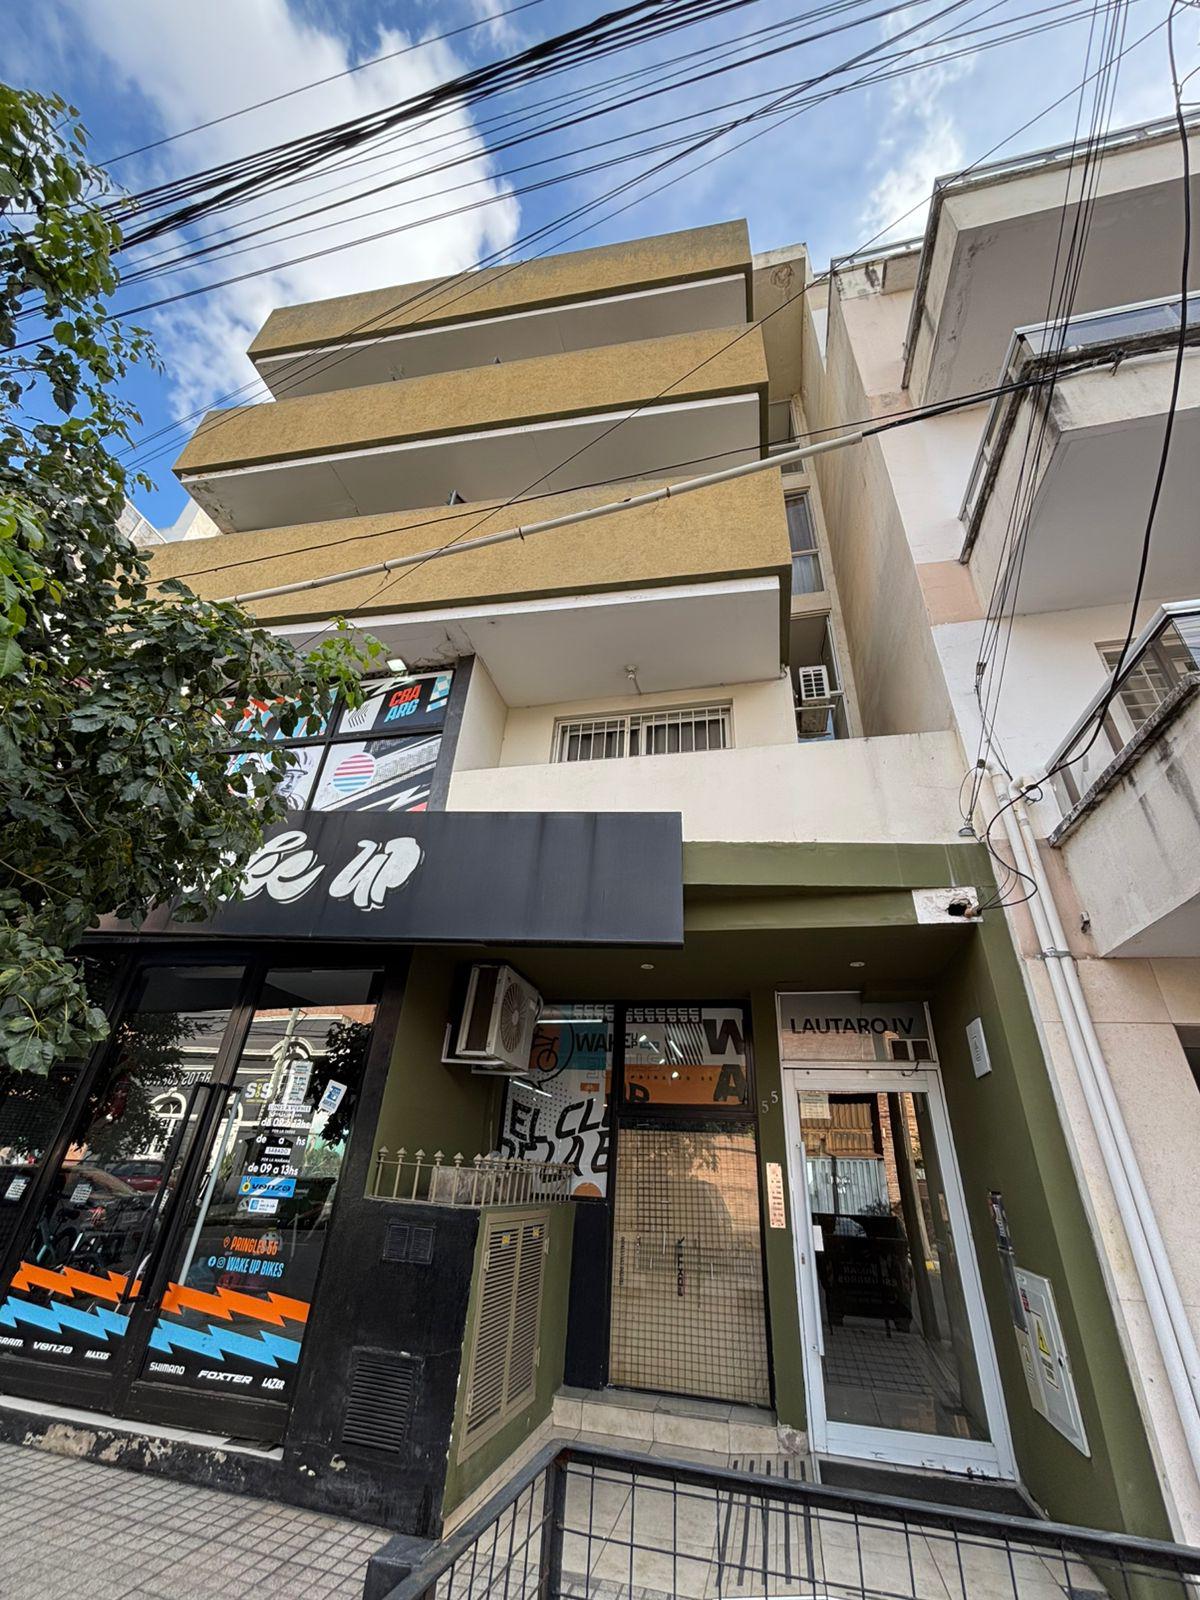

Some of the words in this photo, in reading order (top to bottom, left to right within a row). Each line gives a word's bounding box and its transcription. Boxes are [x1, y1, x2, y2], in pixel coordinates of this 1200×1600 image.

[389, 684, 422, 707] CBA
[384, 699, 420, 723] ARG
[790, 1017, 887, 1034] LAUTARO
[892, 1017, 914, 1034] IV
[256, 1133, 267, 1144] de
[278, 1137, 285, 1145] a
[296, 1135, 306, 1146] hs
[247, 1162, 259, 1173] de
[260, 1163, 272, 1173] 09
[272, 1166, 279, 1174] a
[280, 1164, 299, 1176] 13hs
[230, 1236, 267, 1255] PRINGLES
[266, 1240, 279, 1256] 55
[226, 1256, 250, 1273] WAKE
[248, 1259, 261, 1275] UP
[260, 1260, 285, 1278] BIKES
[149, 1361, 186, 1375] SHIMANO
[197, 1370, 254, 1385] FOXTER
[261, 1377, 286, 1391] LAZER
